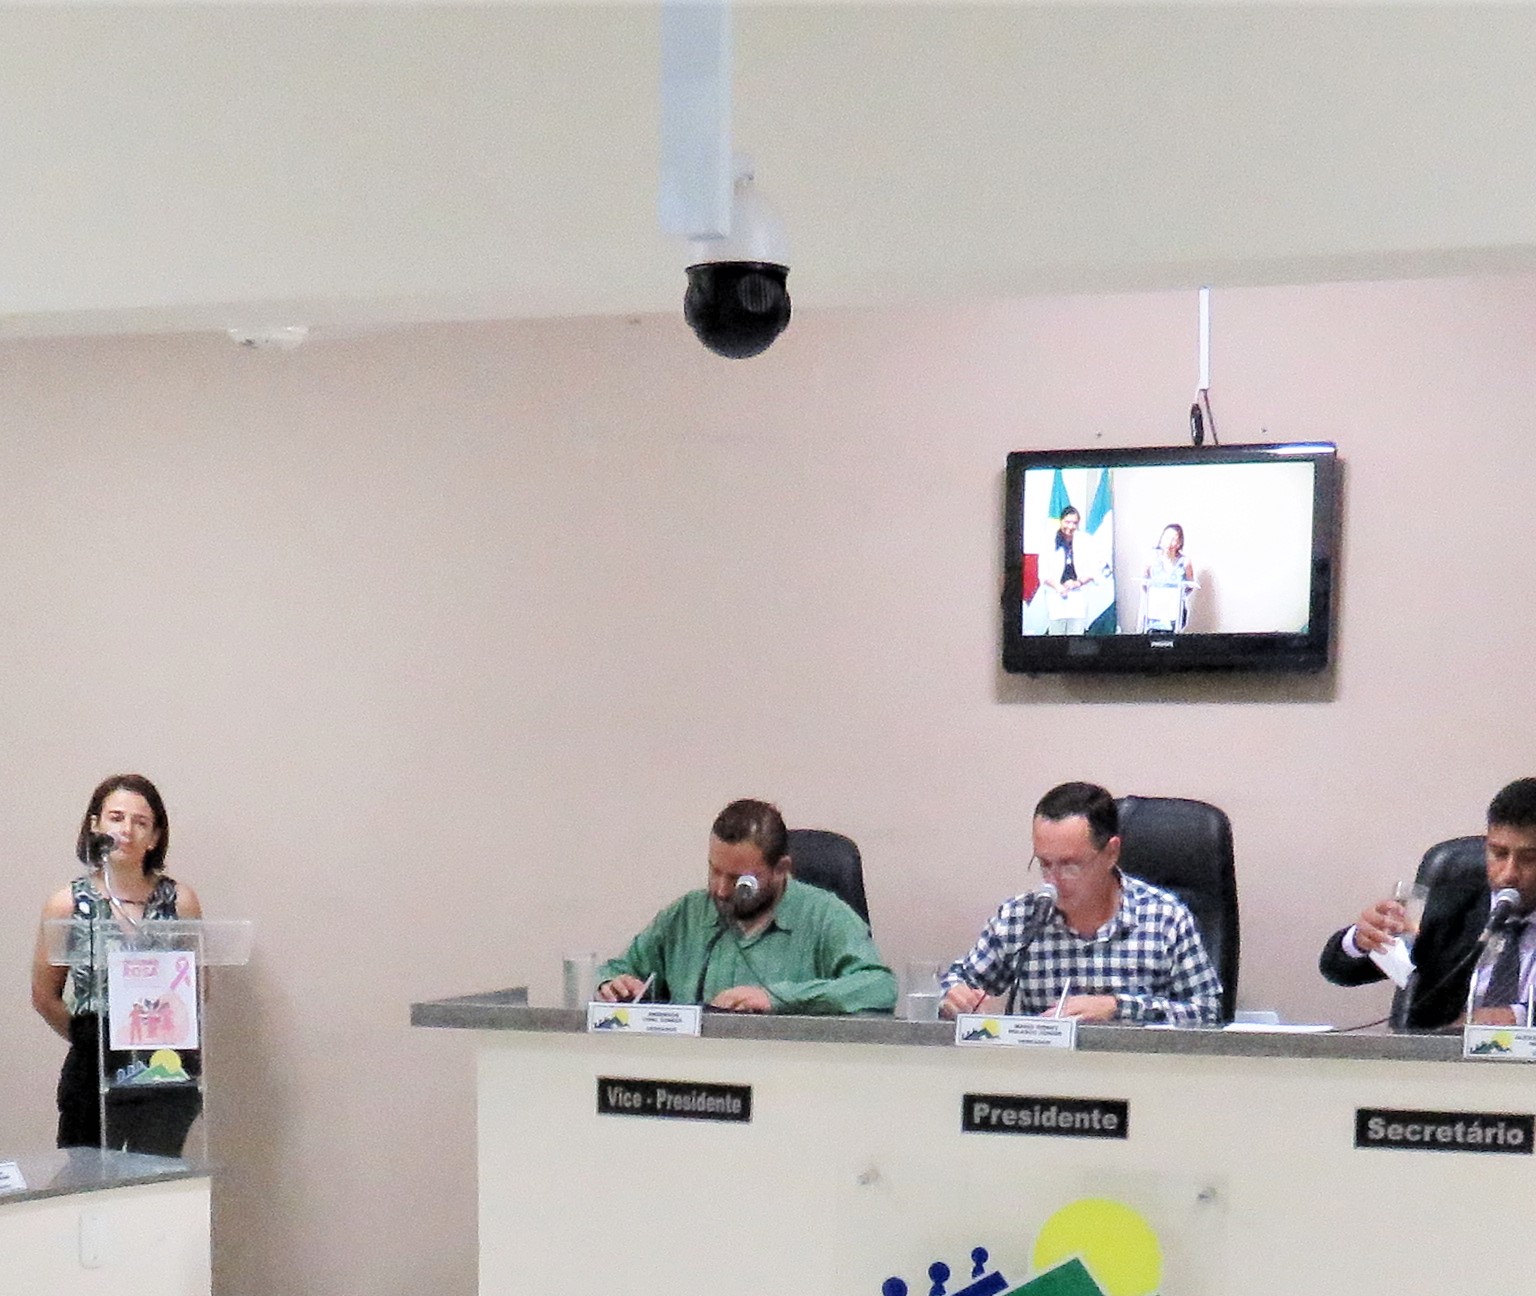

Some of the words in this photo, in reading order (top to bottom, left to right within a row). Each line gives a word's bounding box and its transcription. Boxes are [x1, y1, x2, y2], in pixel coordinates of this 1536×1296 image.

[607, 1086, 642, 1108] Vice
[656, 1088, 742, 1113] Presidente
[973, 1102, 1118, 1130] Presidente
[1367, 1116, 1524, 1145] Secretário
